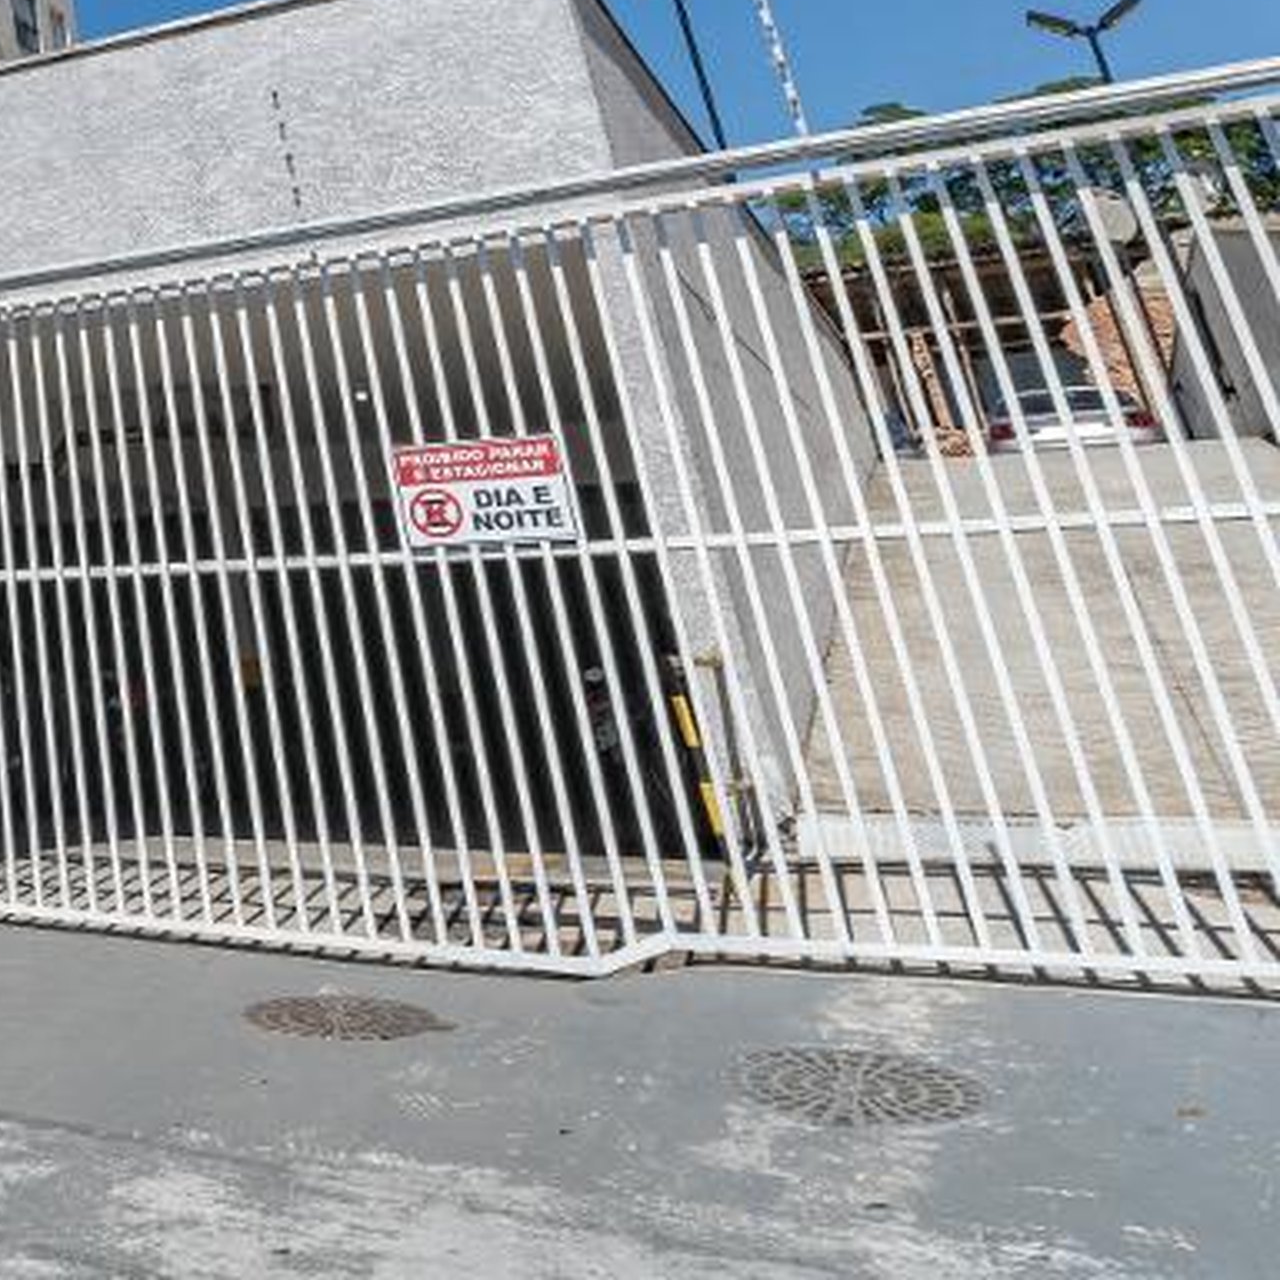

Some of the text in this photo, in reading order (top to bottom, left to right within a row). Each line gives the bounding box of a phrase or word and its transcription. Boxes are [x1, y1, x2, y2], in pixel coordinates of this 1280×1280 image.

[473, 485, 553, 508] DIA E
[471, 507, 563, 531] NOITE
